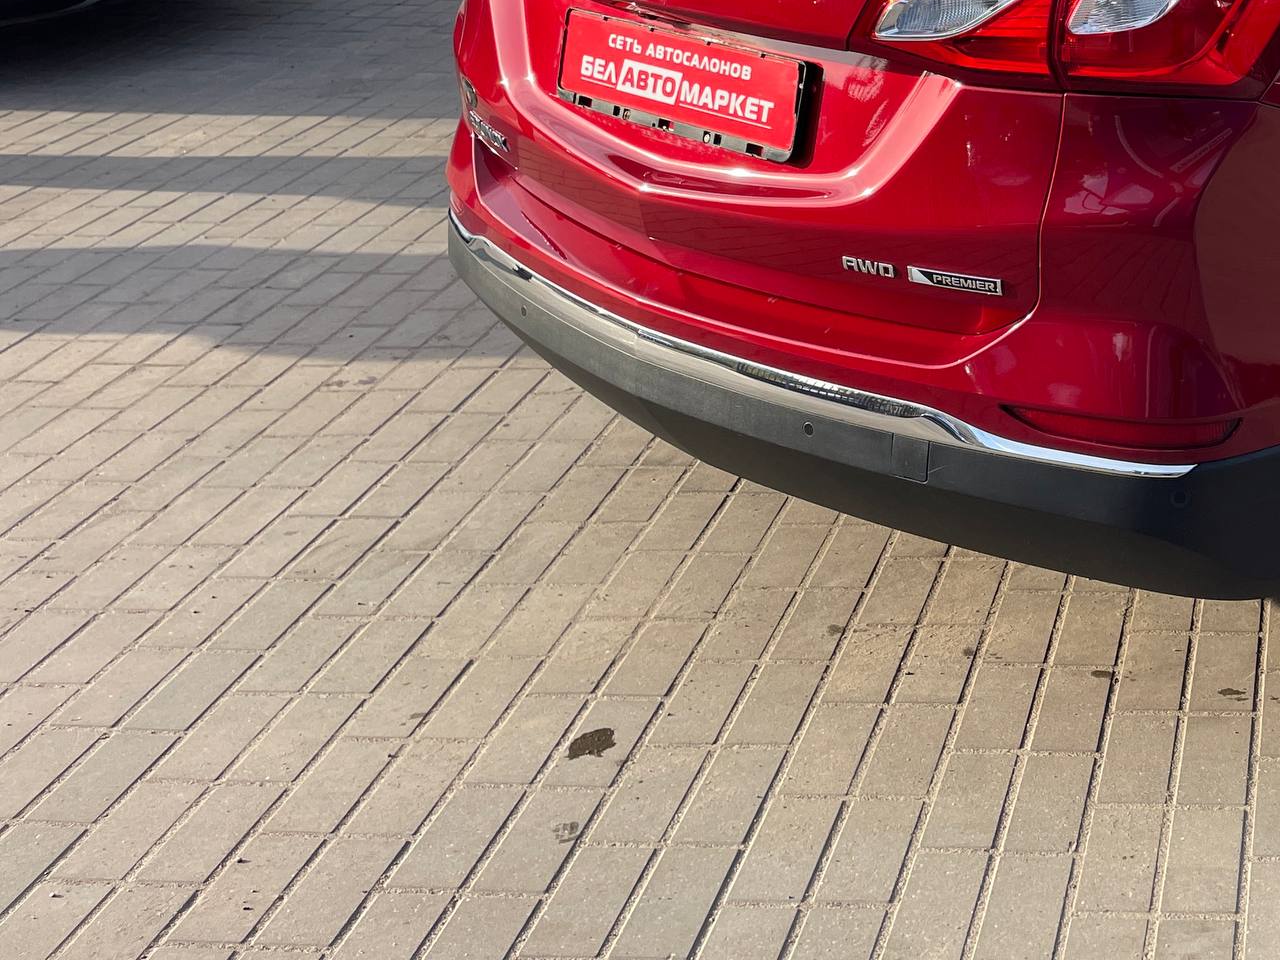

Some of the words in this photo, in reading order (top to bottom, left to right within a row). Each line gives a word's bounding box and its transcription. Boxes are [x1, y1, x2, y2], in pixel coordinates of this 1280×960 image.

[608, 33, 642, 54] СЕТЬ
[645, 42, 752, 80] АВТОСАЛОНОВ
[842, 255, 895, 279] AWD
[932, 274, 995, 292] PREMIER
